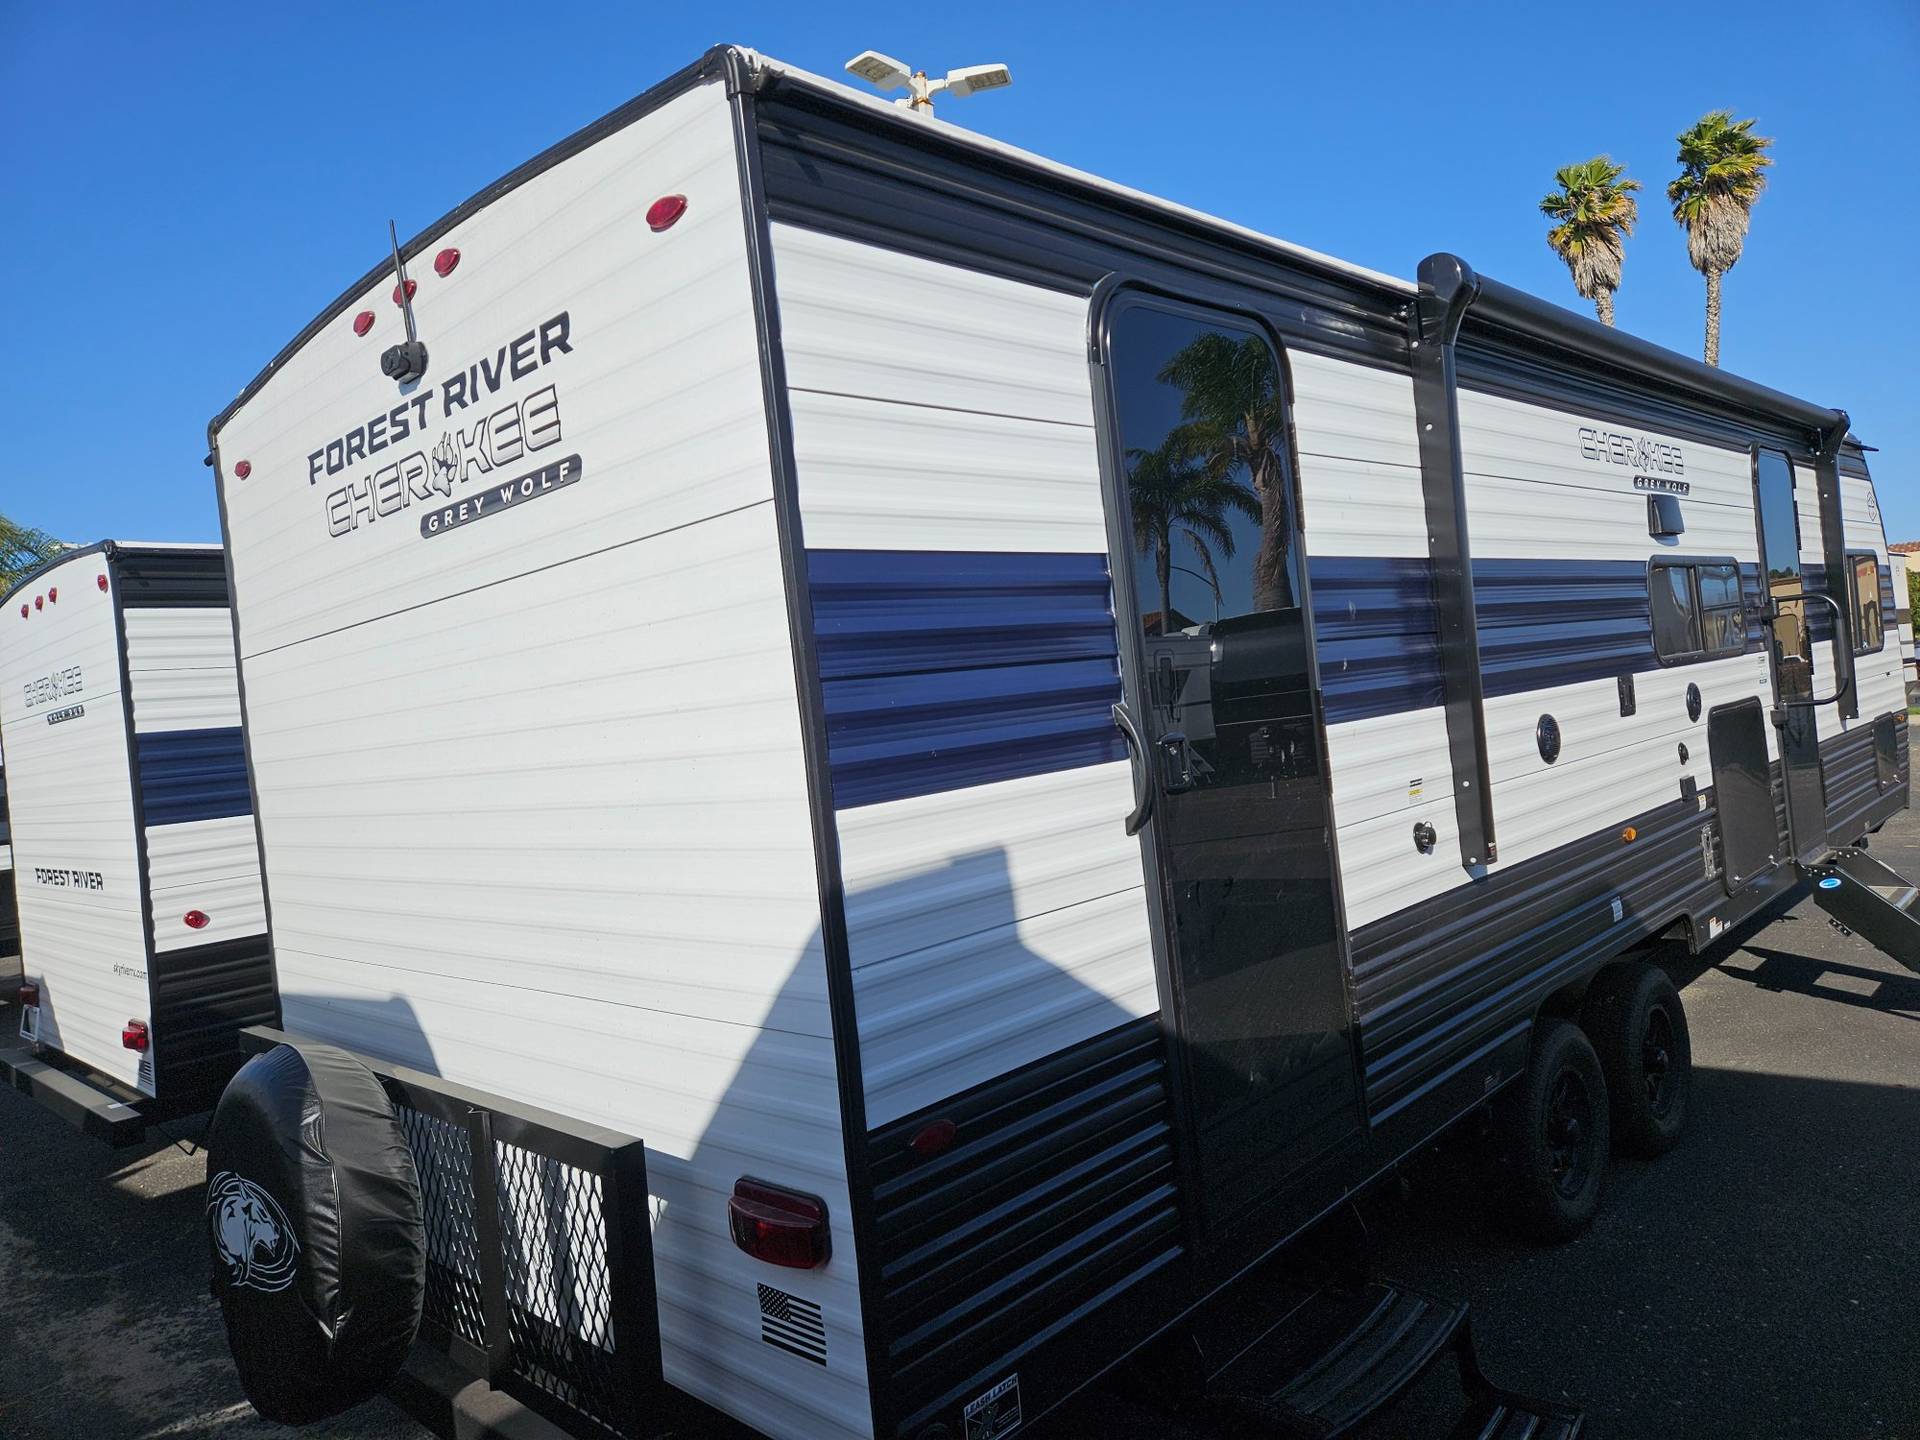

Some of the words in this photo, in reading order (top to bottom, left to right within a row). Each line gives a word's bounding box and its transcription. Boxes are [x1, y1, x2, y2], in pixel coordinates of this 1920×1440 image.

[307, 389, 434, 486] FOREST
[441, 311, 574, 418] RIVER
[326, 383, 562, 538] CHEROKEE
[1578, 427, 1684, 475] CHEROKEE
[428, 496, 485, 532] GREY
[501, 461, 570, 504] WOLF
[1637, 478, 1661, 489] GREY
[1665, 481, 1688, 493] WOLF
[35, 867, 70, 887] FOREST
[71, 871, 104, 891] RIVER
